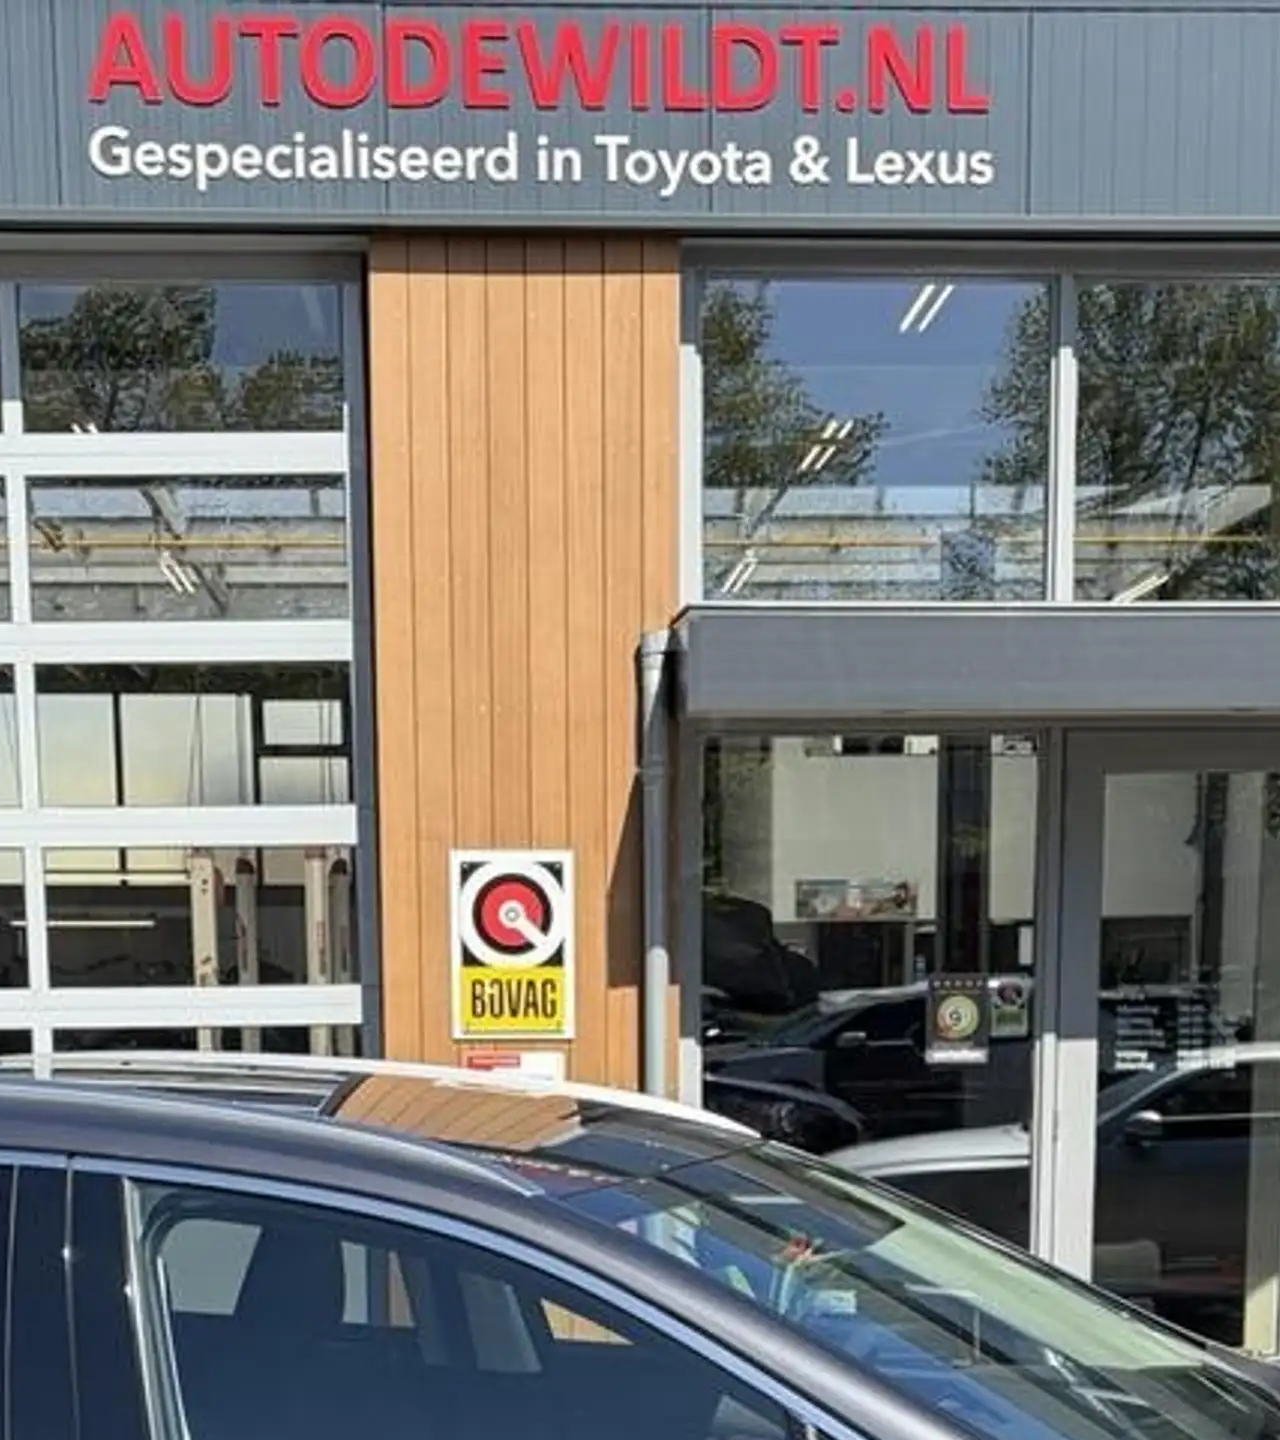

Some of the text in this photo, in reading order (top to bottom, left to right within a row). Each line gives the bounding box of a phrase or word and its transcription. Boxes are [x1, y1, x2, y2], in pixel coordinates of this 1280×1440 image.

[86, 13, 990, 113] AUTODEWILDT.NL
[87, 125, 995, 197] Gespecialiseerd in Toyota & Lexus
[470, 977, 558, 1020] BOVAG
